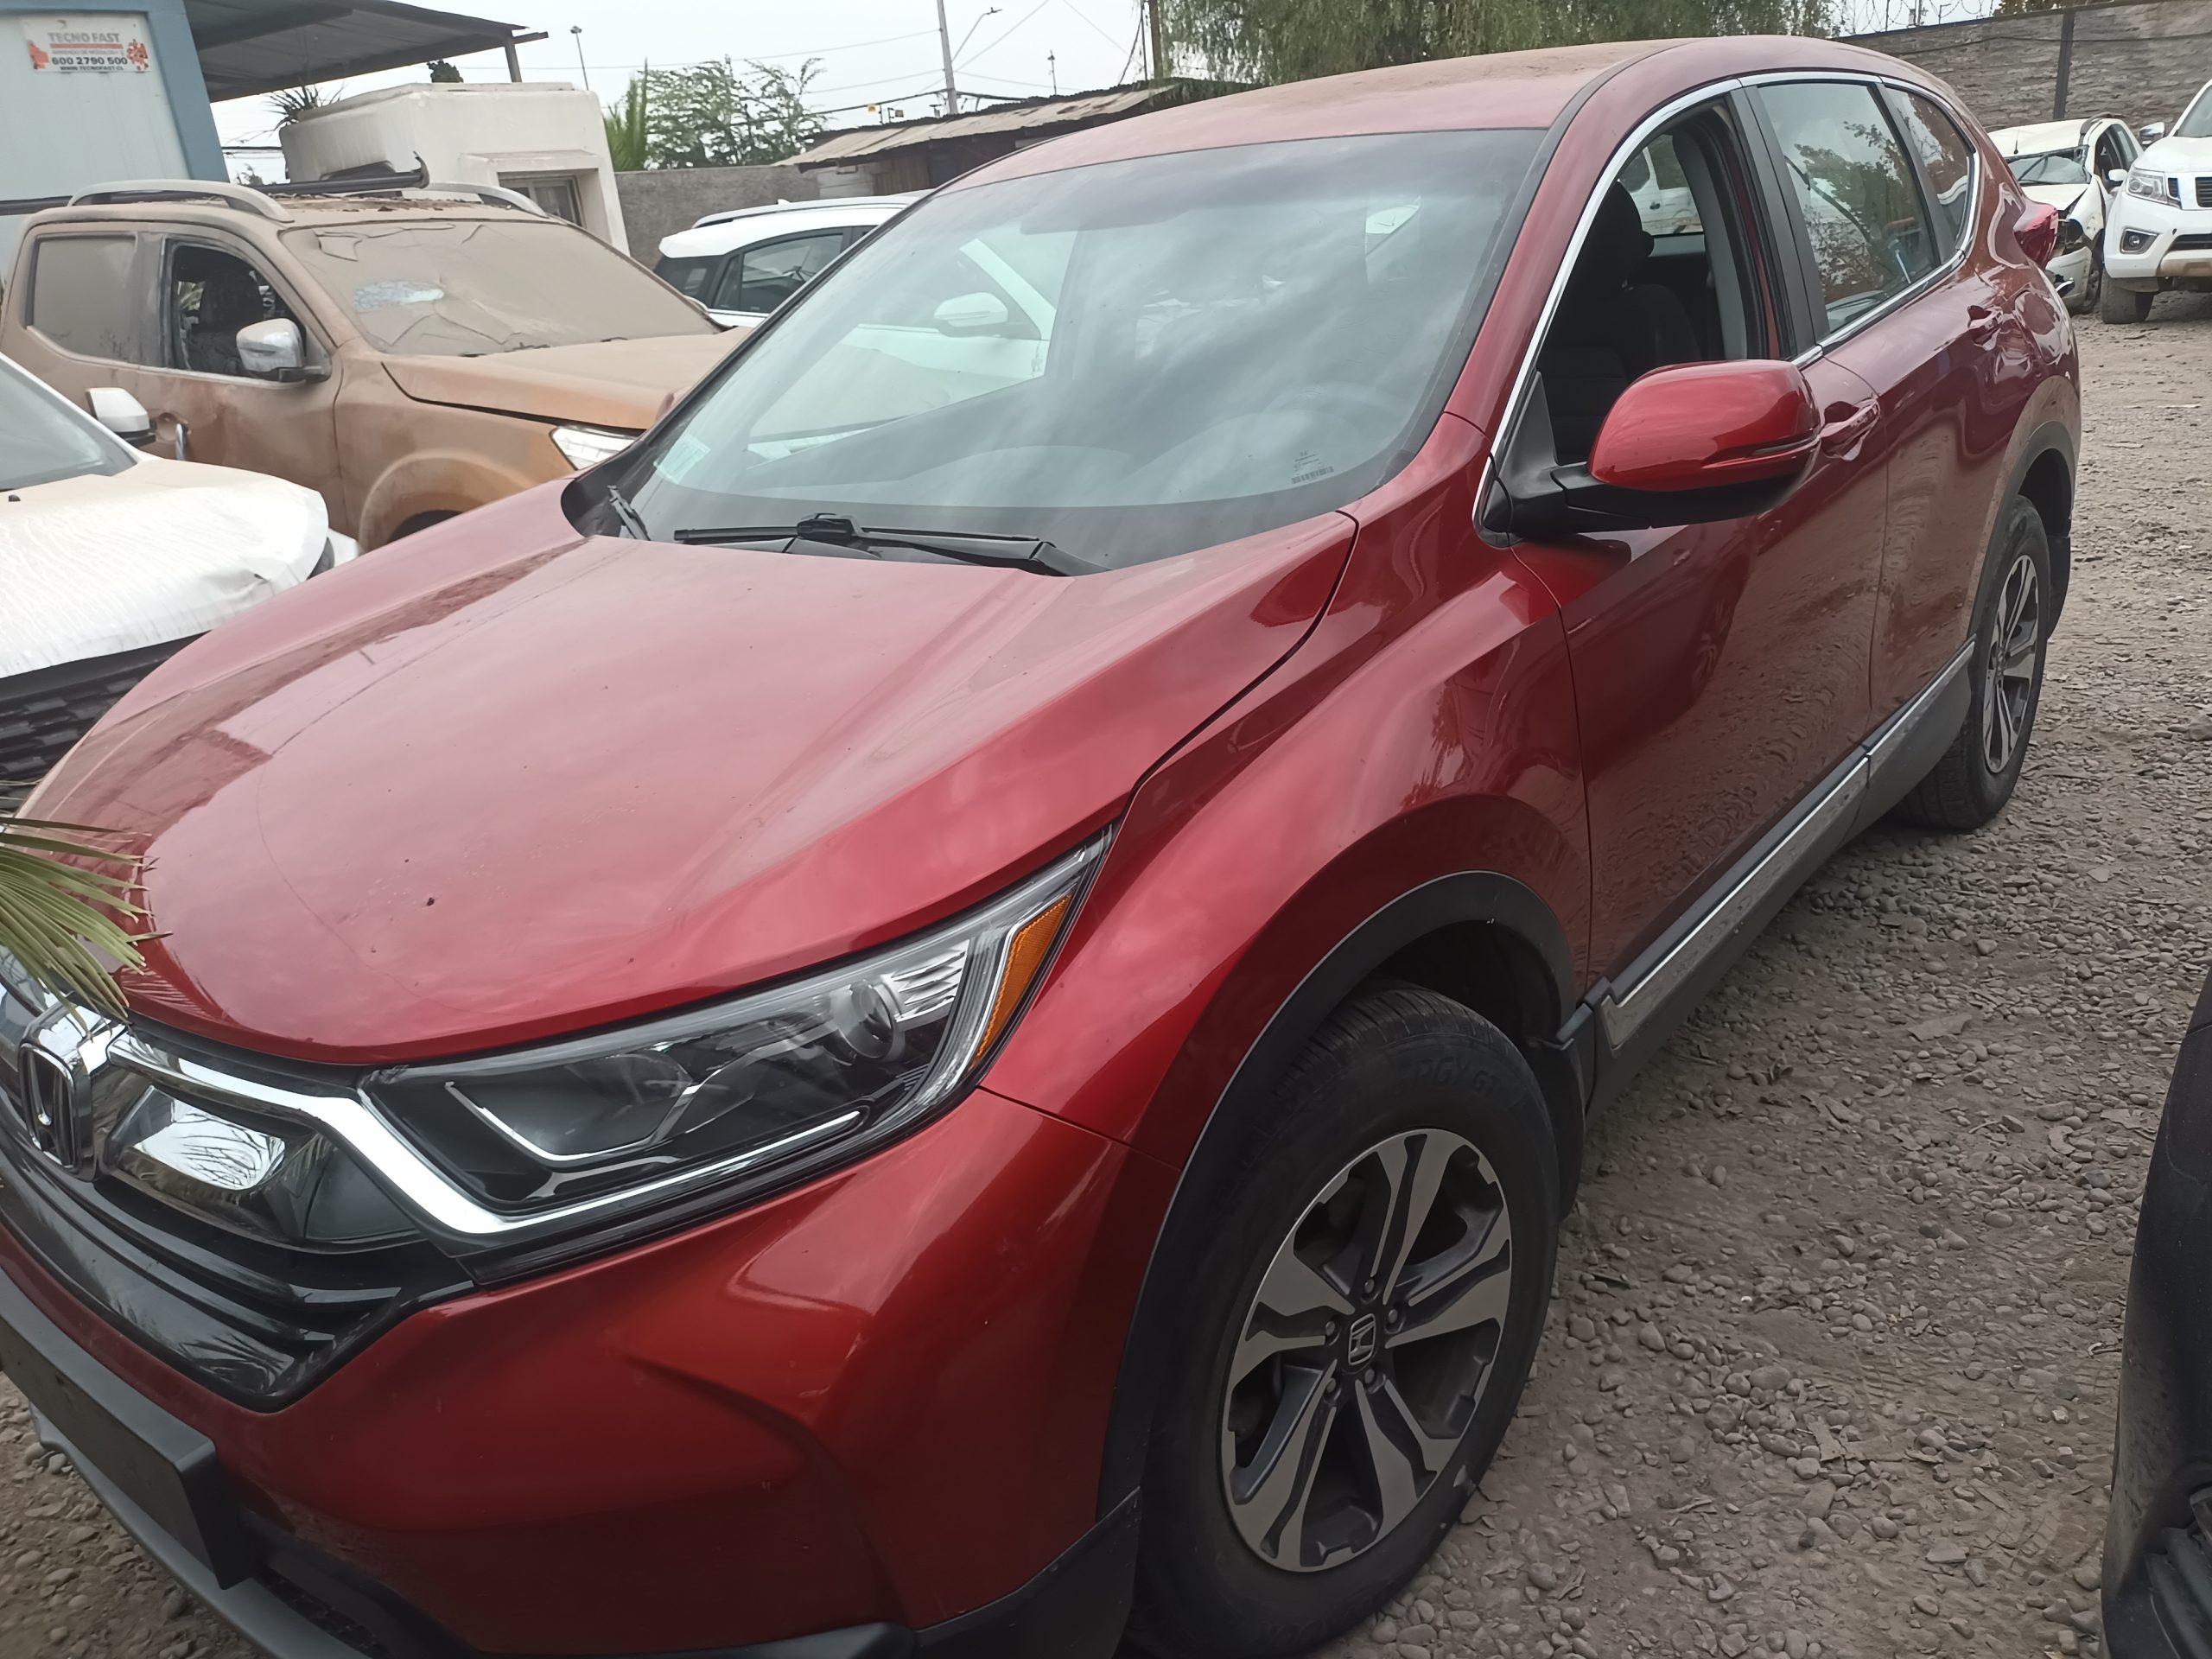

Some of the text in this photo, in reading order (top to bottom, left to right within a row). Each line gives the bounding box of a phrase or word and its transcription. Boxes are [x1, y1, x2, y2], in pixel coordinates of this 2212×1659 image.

[48, 33, 120, 42] TECNO FAST
[52, 57, 128, 66] 600 2790 500
